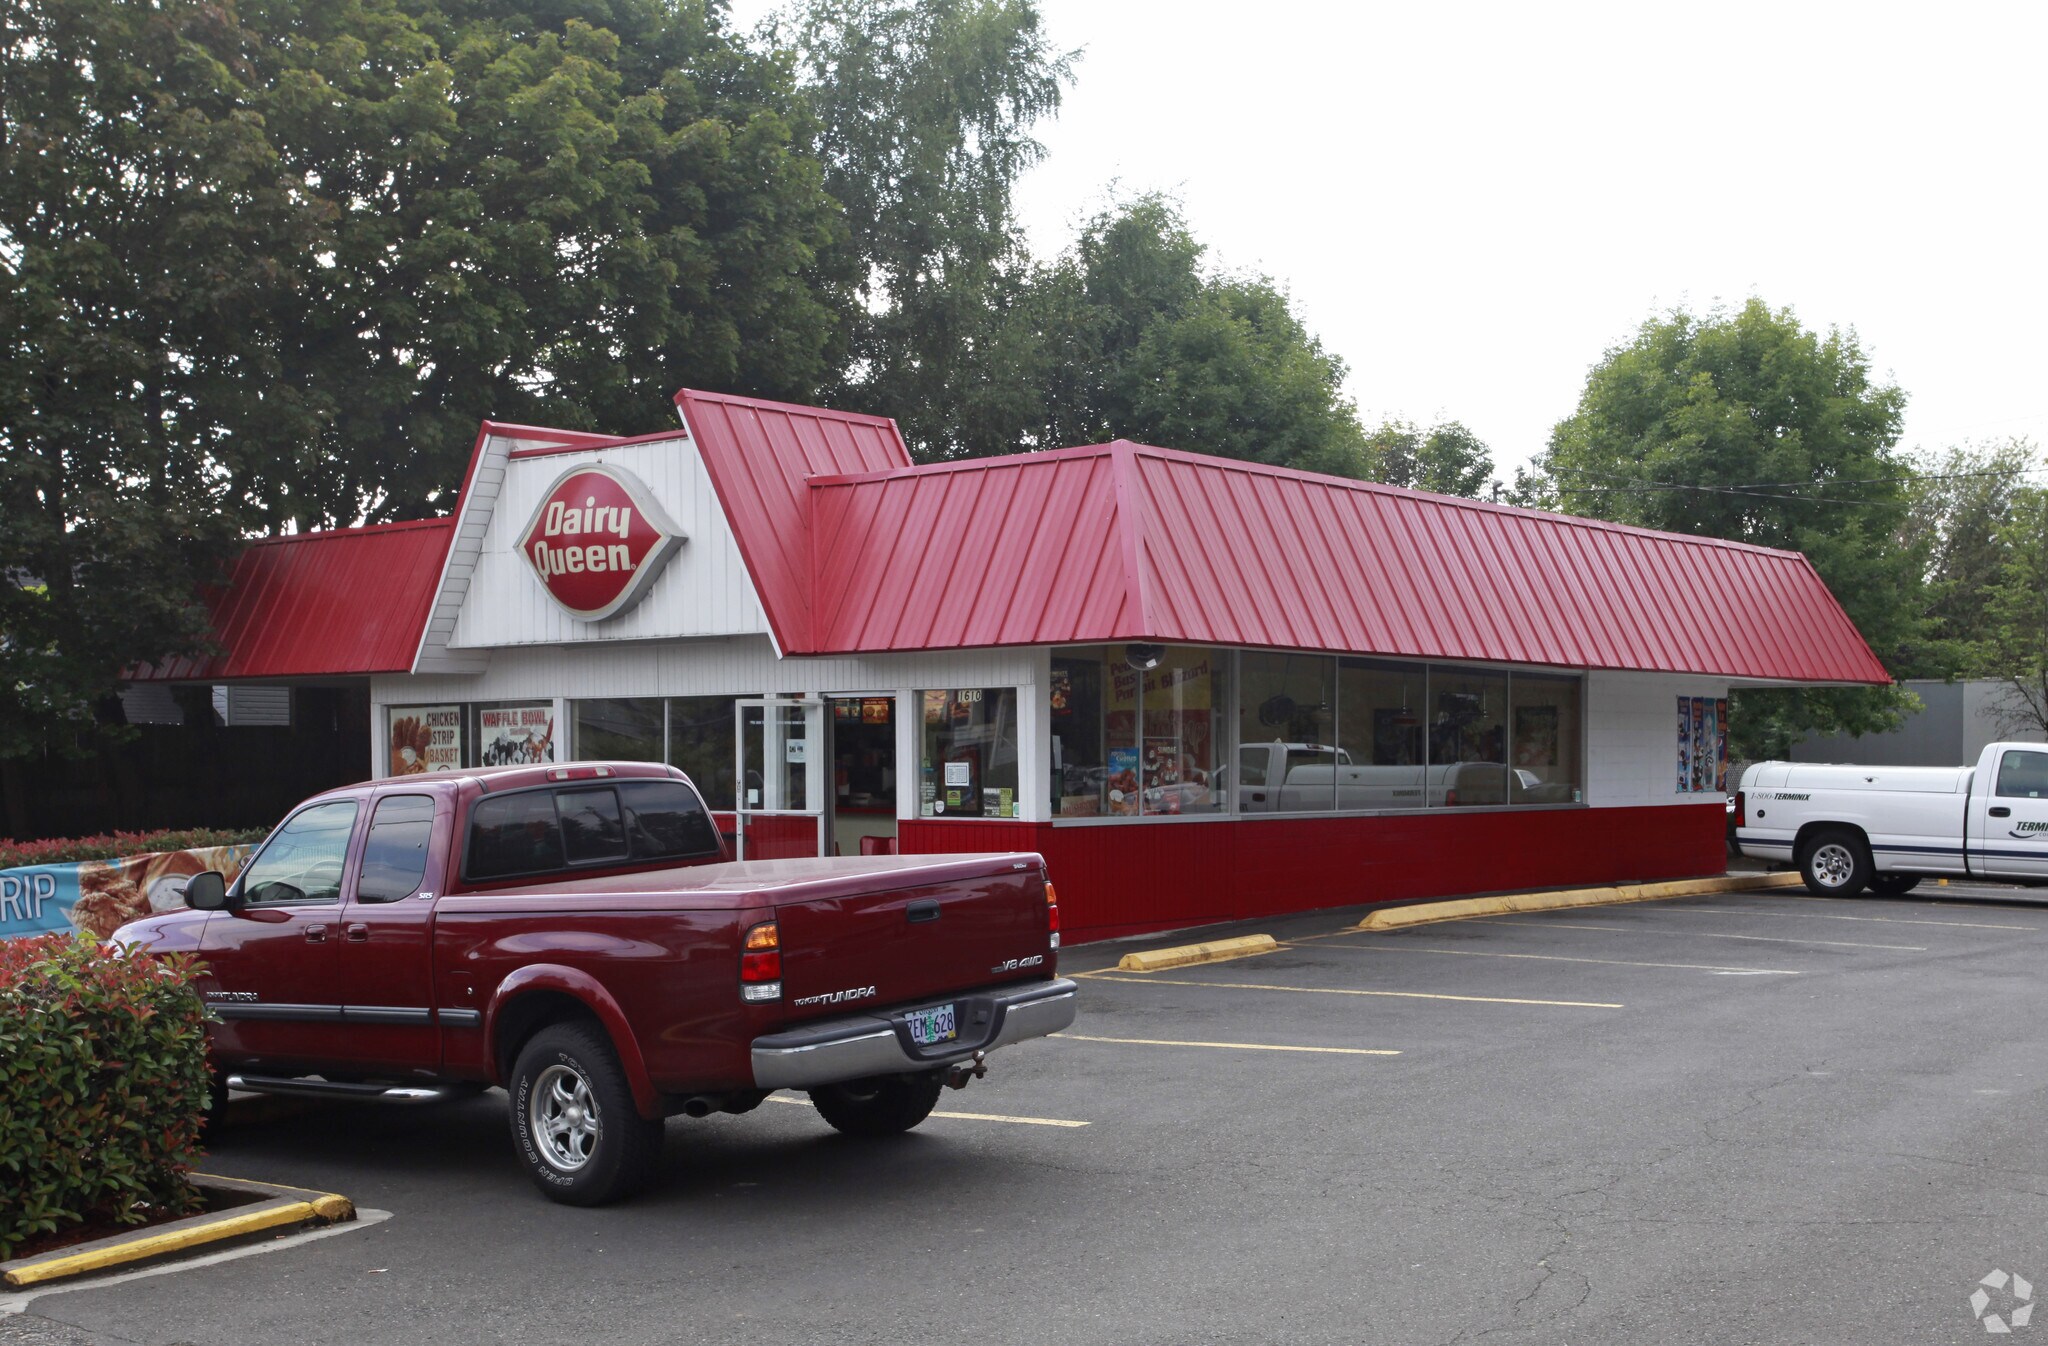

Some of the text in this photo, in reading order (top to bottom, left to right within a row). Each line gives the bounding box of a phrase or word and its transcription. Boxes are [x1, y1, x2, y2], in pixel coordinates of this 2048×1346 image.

[545, 496, 632, 539] Dairy
[534, 541, 632, 583] Queen
[1115, 660, 1209, 702] Parait Blzard
[959, 690, 982, 701] 1610
[426, 711, 460, 727] CHICKEN
[482, 709, 548, 727] WAFFLE BOWL
[432, 730, 455, 745] STRIP
[429, 748, 459, 763] BASKET
[1750, 792, 1811, 801] 1-800-TERMINIX
[1002, 958, 1018, 971] V8
[1019, 954, 1044, 968] 4WD
[793, 985, 877, 1006] TOYOTA TUNDRA
[933, 1012, 954, 1034] 628
[538, 1166, 574, 1186] OPEN
